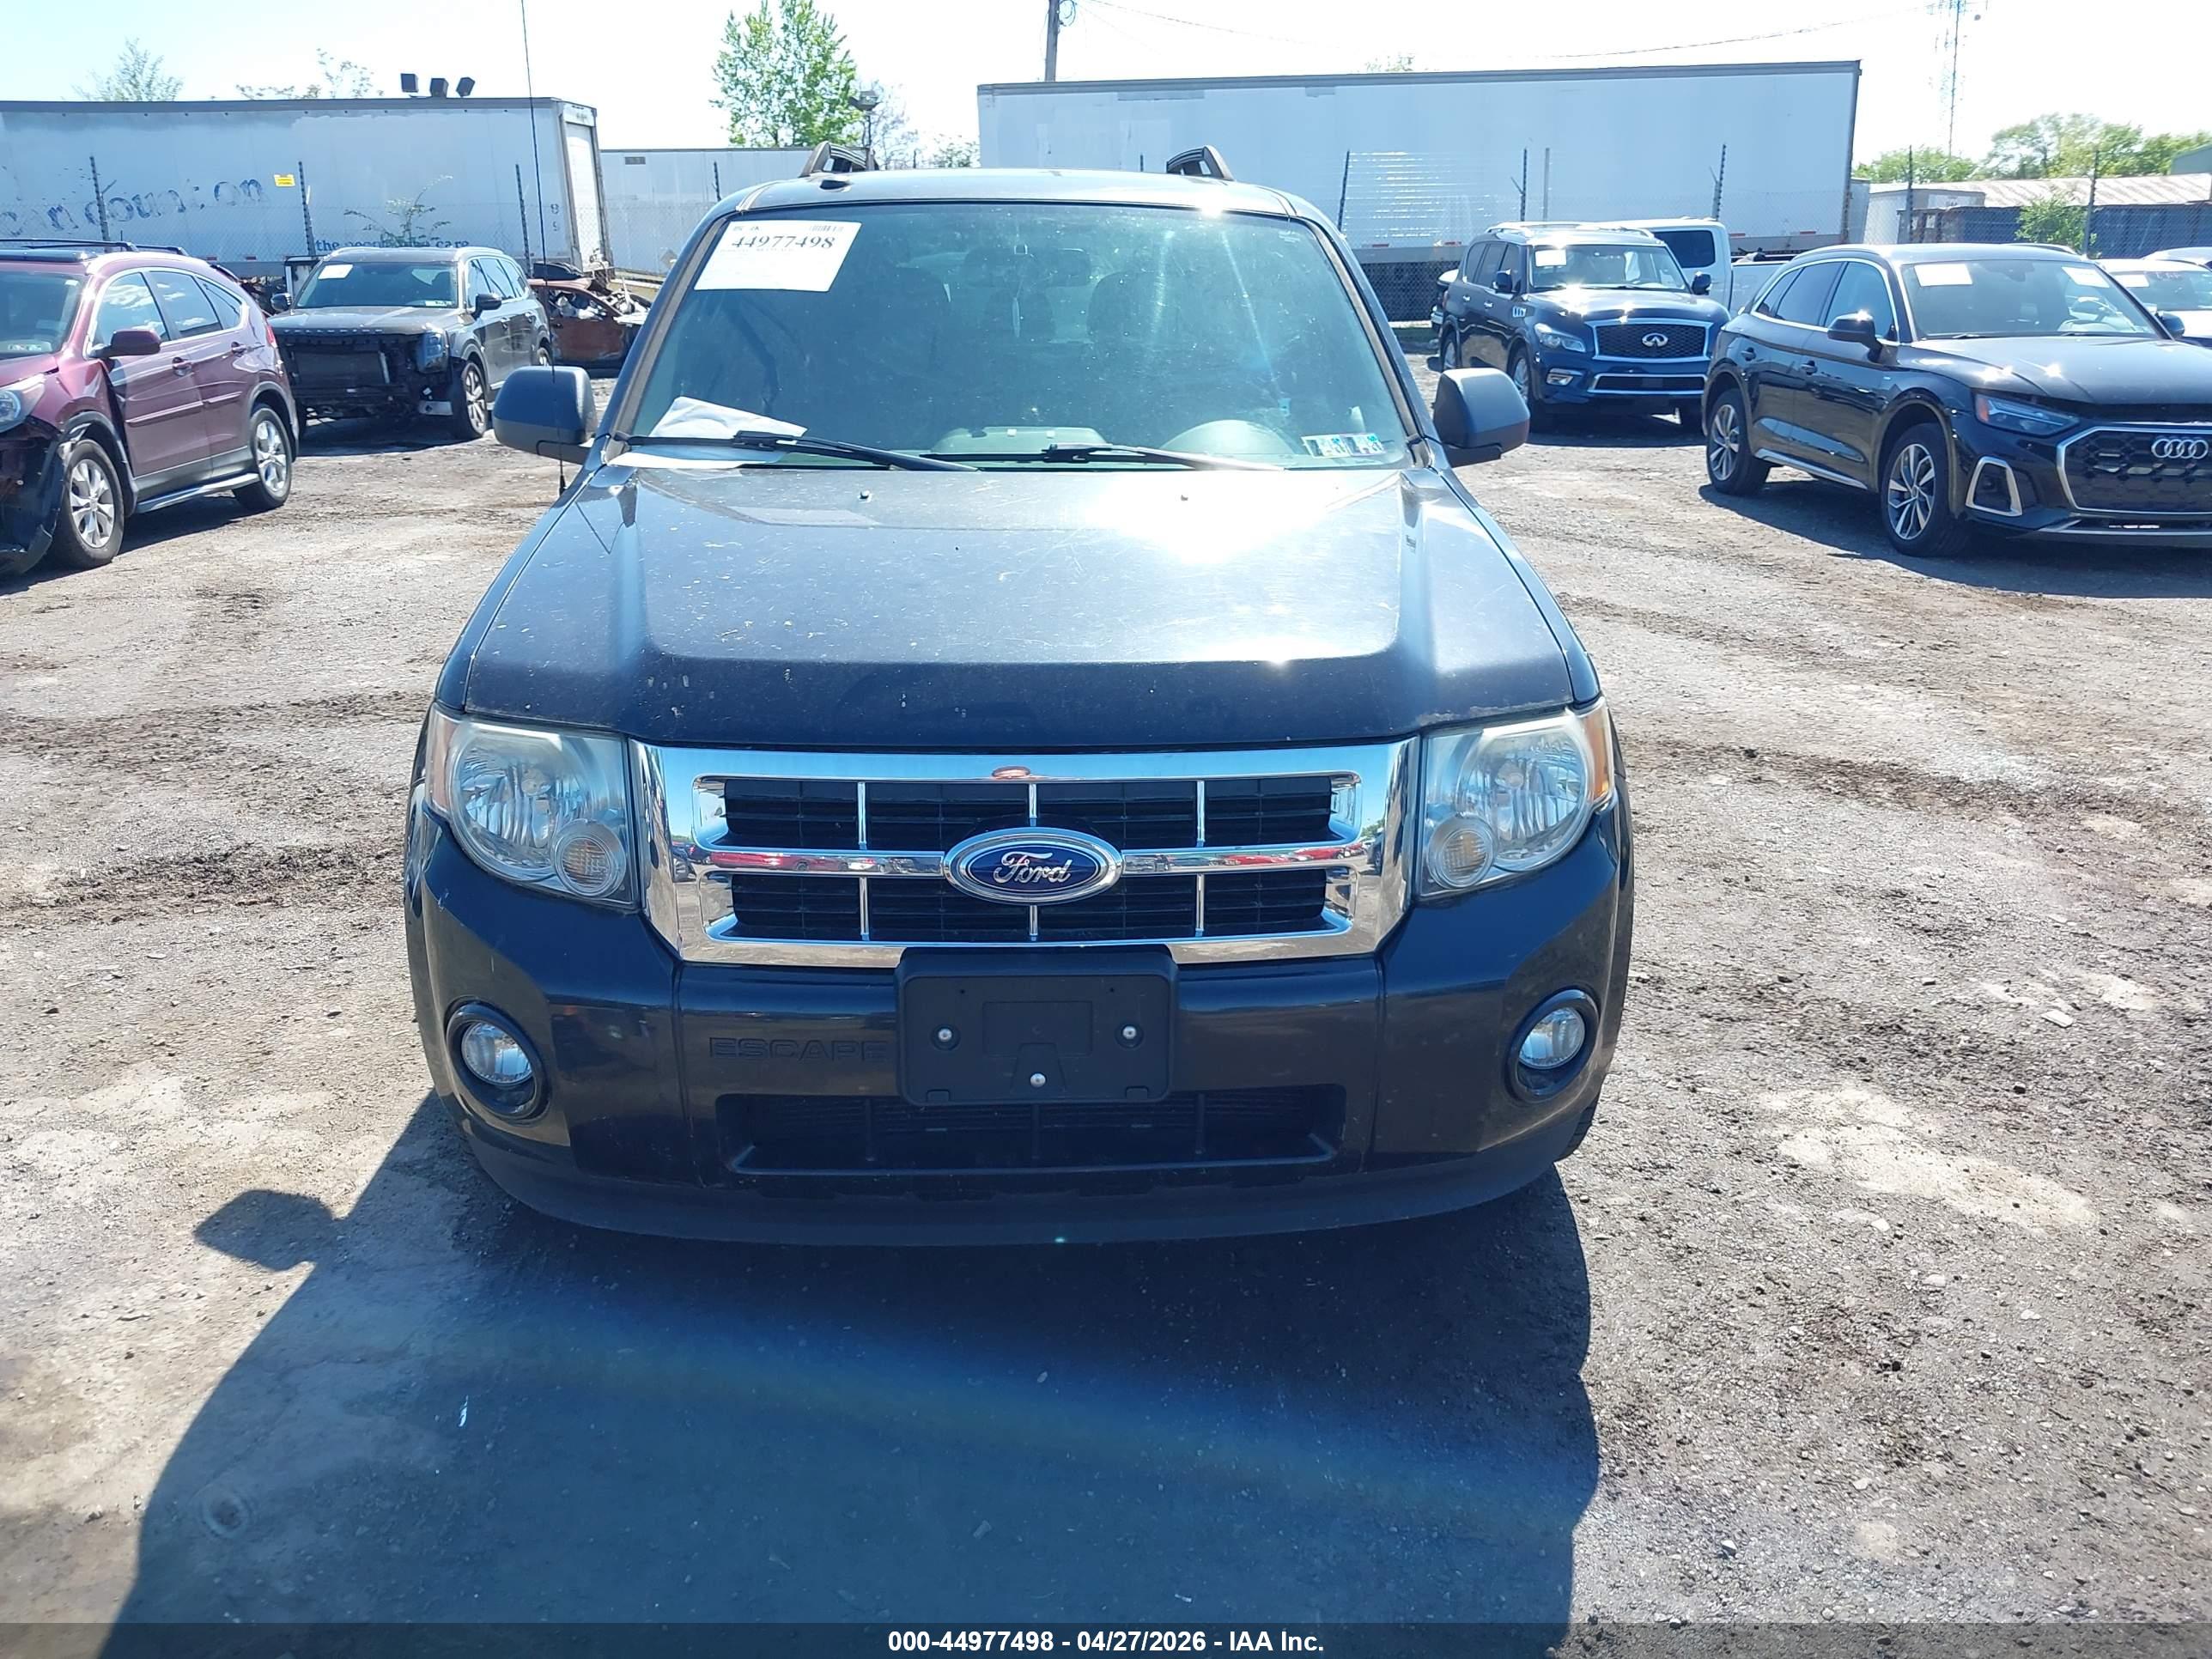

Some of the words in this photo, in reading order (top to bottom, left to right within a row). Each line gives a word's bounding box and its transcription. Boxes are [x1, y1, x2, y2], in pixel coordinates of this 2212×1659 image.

[315, 239, 340, 252] the
[732, 235, 836, 249] 44977498
[993, 851, 1073, 884] Ford
[709, 1037, 890, 1061] ESCAPE
